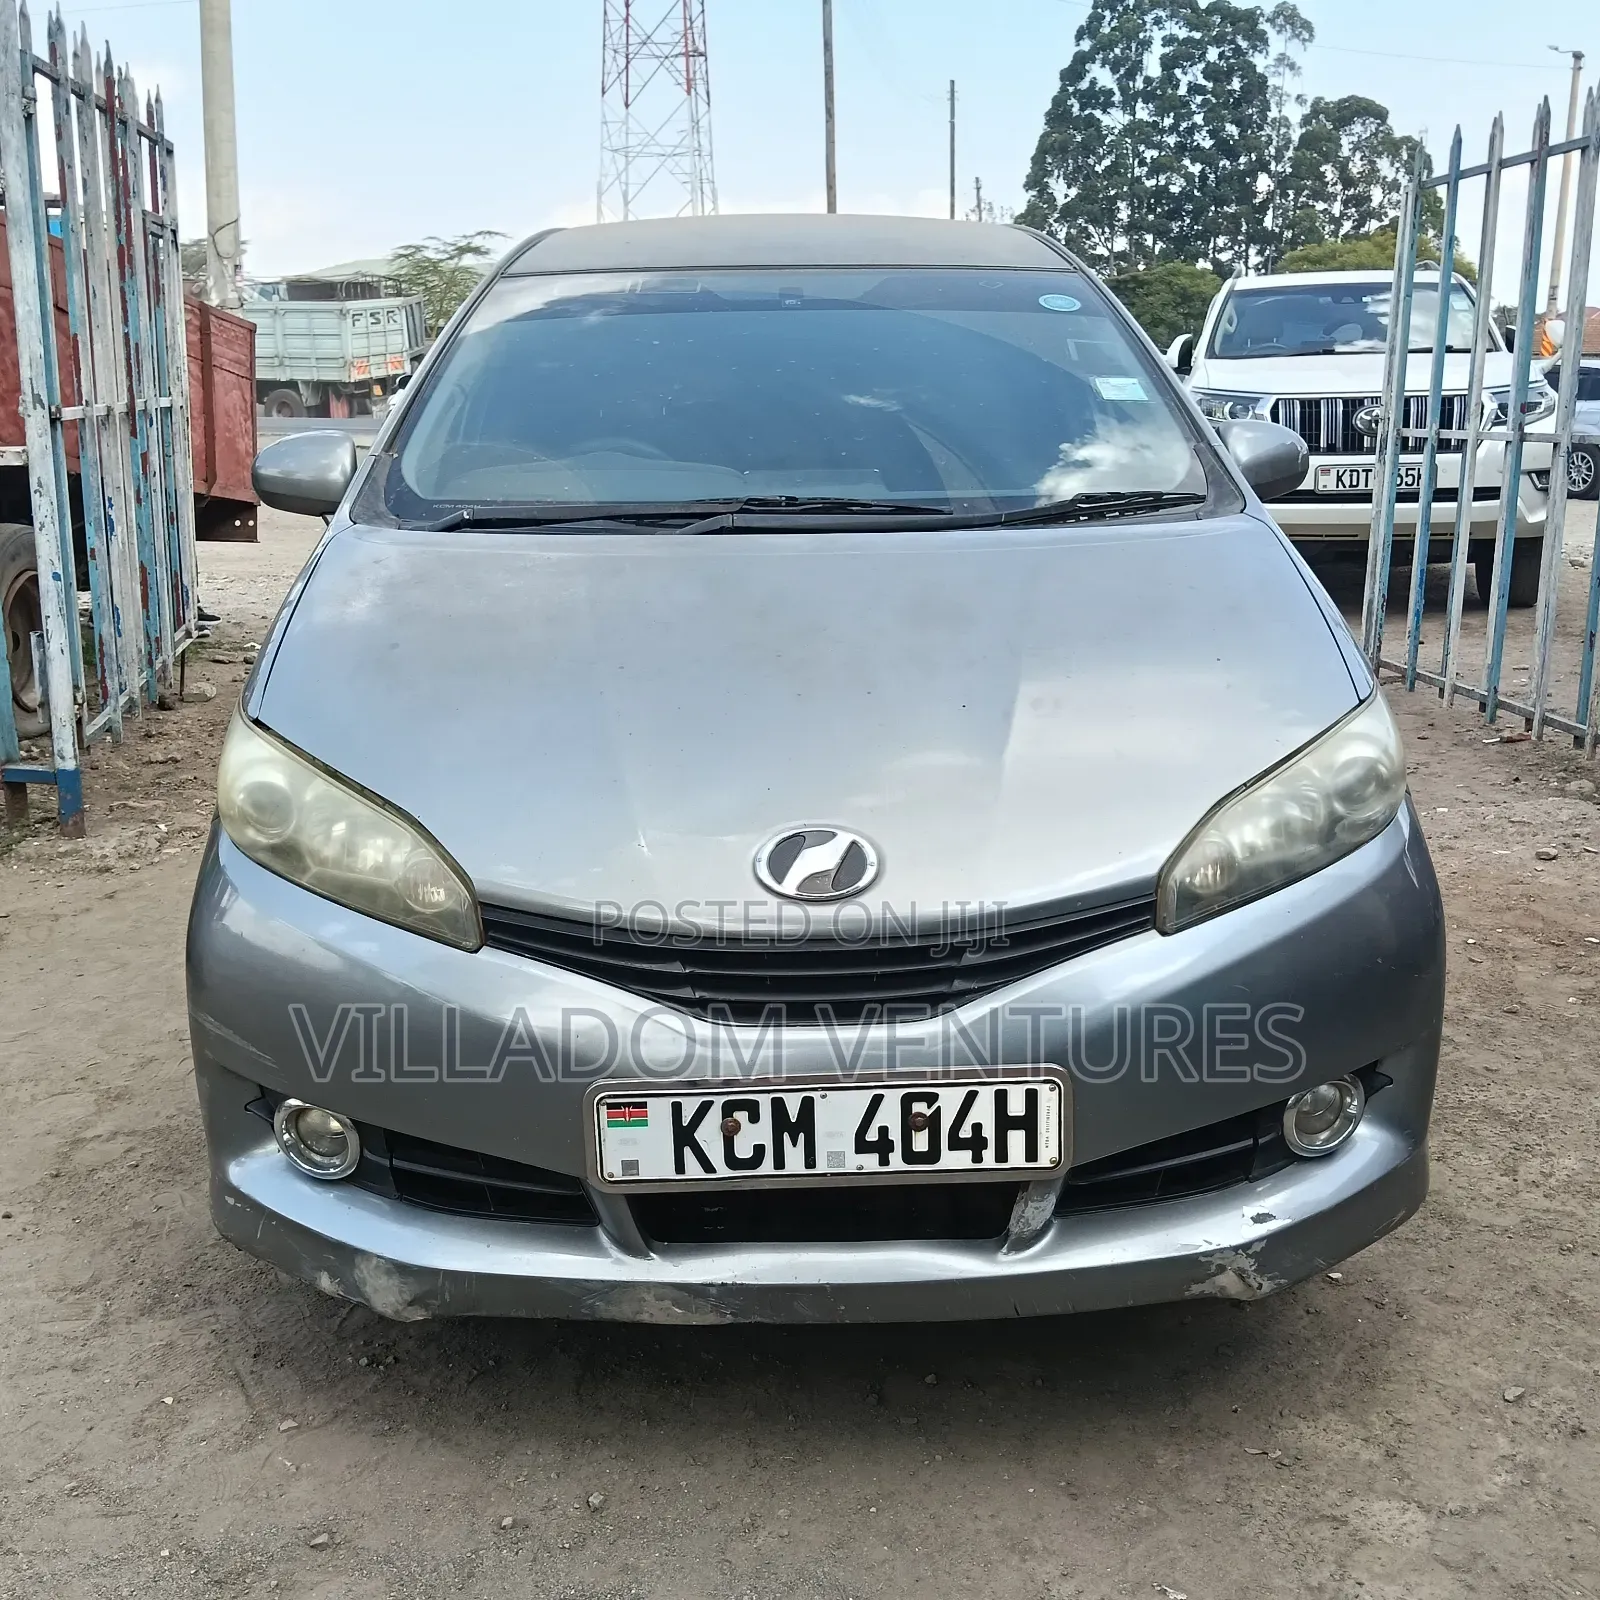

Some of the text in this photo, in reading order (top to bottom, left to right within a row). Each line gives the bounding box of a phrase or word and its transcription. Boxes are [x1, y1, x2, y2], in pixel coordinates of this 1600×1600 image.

[351, 309, 398, 328] FSR
[1335, 468, 1373, 488] KDT
[670, 1094, 817, 1175] KCM
[853, 1087, 1039, 1168] 404H
